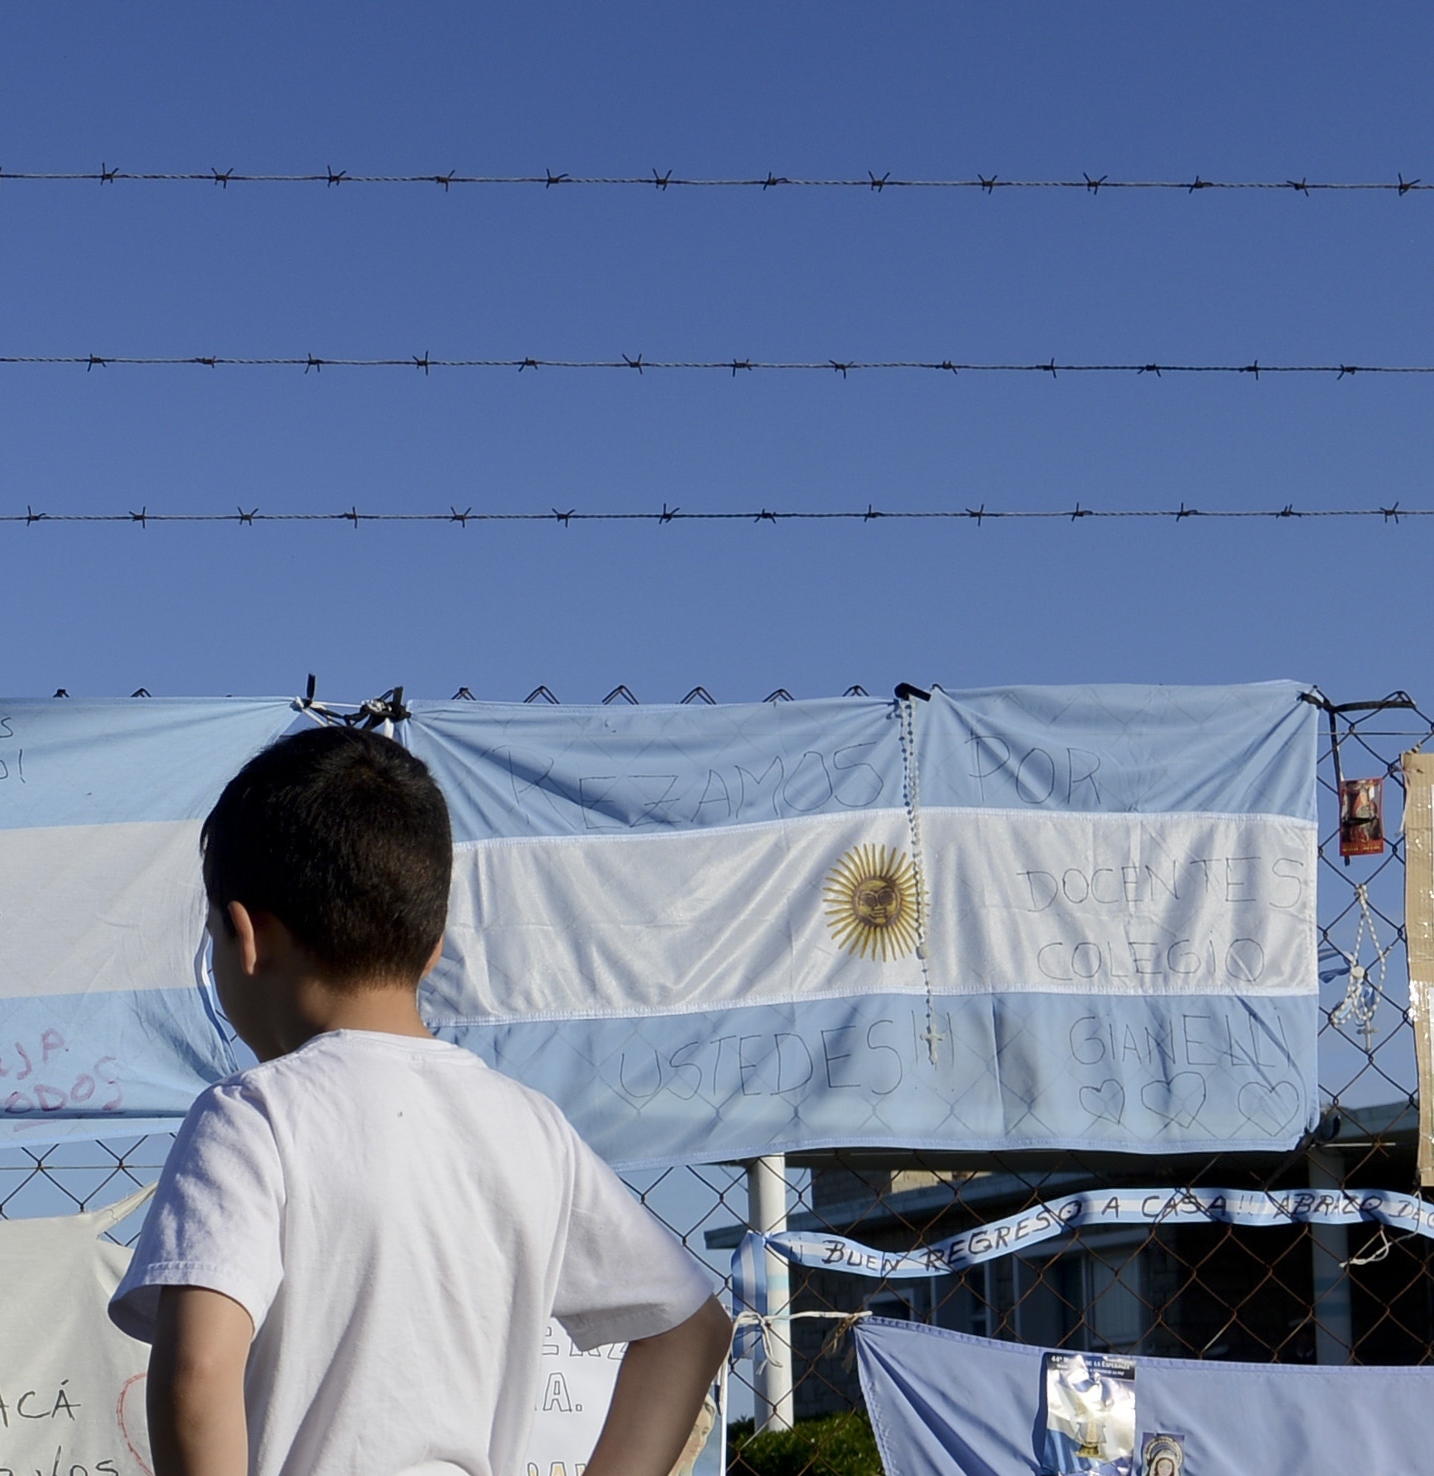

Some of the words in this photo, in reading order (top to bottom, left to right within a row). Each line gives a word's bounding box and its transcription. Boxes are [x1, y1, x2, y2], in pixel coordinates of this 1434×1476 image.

[492, 741, 885, 830] REZAMOS
[964, 734, 1102, 805] POR
[1016, 856, 1305, 913] DOCENTES
[1069, 1013, 1292, 1068] GIANELLI
[821, 1239, 900, 1279] BUEN
[920, 1200, 1083, 1273] REGRESO
[1101, 1196, 1121, 1218] A
[1141, 1195, 1228, 1219] CASA
